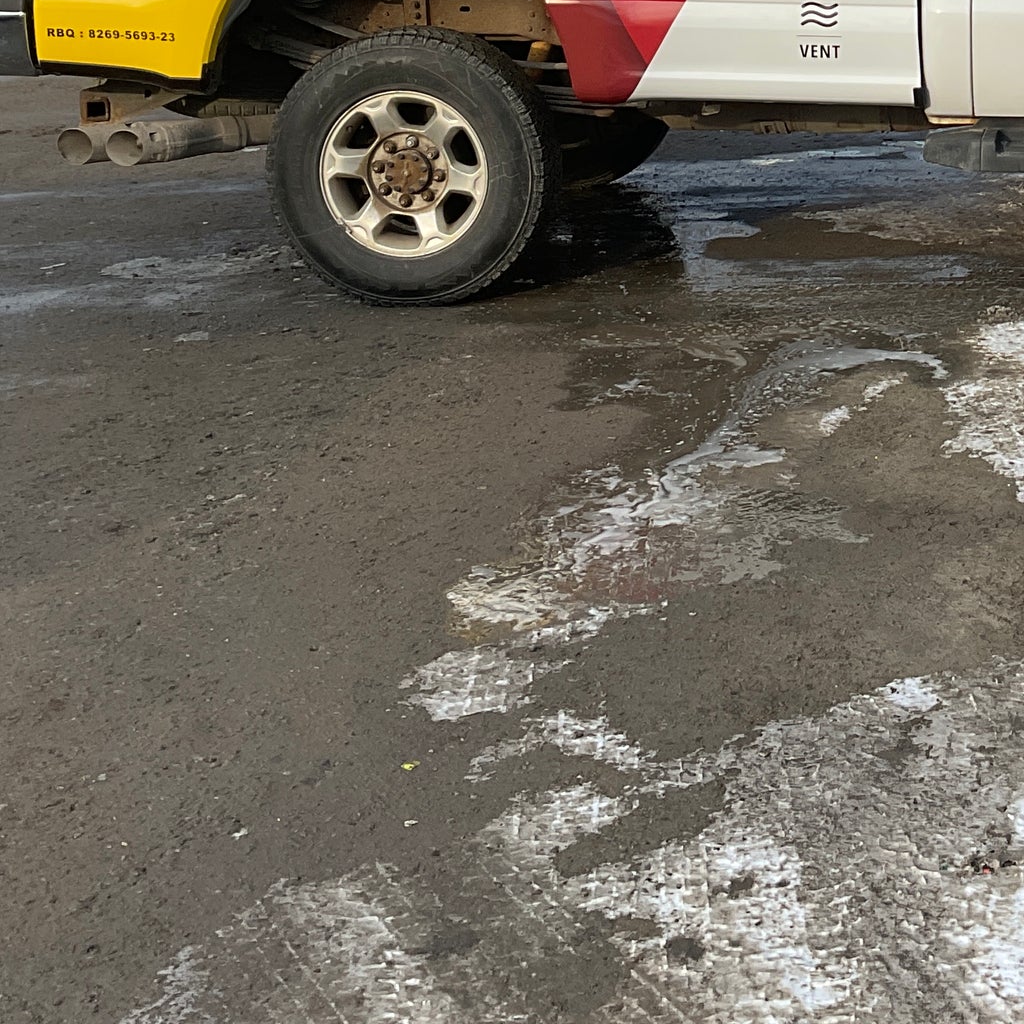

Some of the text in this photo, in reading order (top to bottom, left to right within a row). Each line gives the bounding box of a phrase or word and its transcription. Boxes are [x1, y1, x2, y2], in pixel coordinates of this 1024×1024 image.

[47, 28, 75, 38] RBQ
[88, 29, 176, 42] 8269-5693-23
[800, 44, 841, 59] VENT
